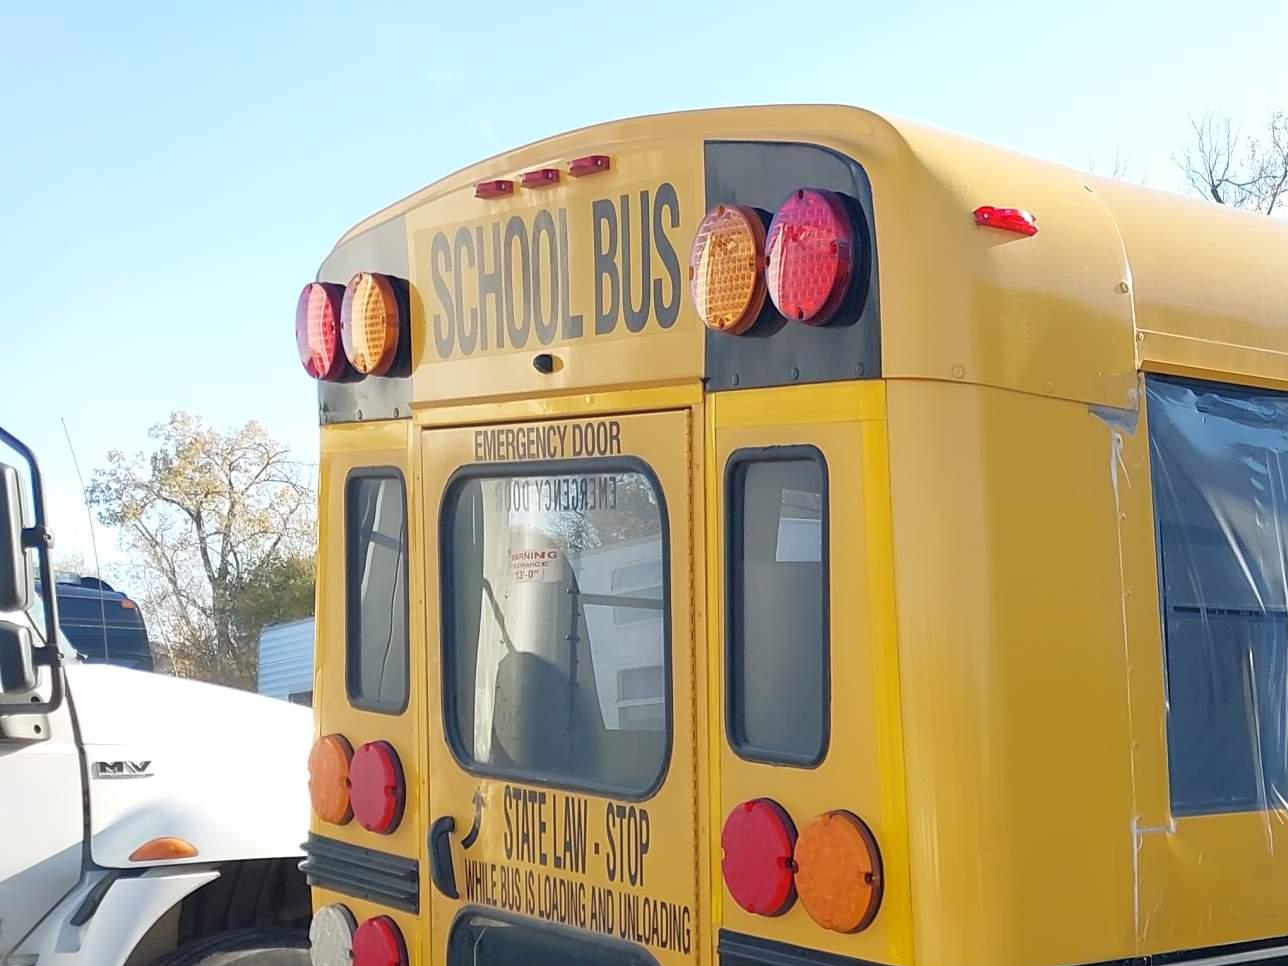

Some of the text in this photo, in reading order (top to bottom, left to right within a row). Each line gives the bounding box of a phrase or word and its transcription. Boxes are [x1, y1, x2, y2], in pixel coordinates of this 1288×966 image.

[431, 181, 682, 360] SCHOOL BUS
[474, 420, 622, 462] EMERGENCY DOOR
[96, 760, 153, 775] MV
[503, 784, 547, 866] STATE
[553, 794, 588, 874] LAW
[606, 801, 650, 887] STOP
[464, 859, 691, 955] WHILE BUS IS LOADING AND UNLOADING
